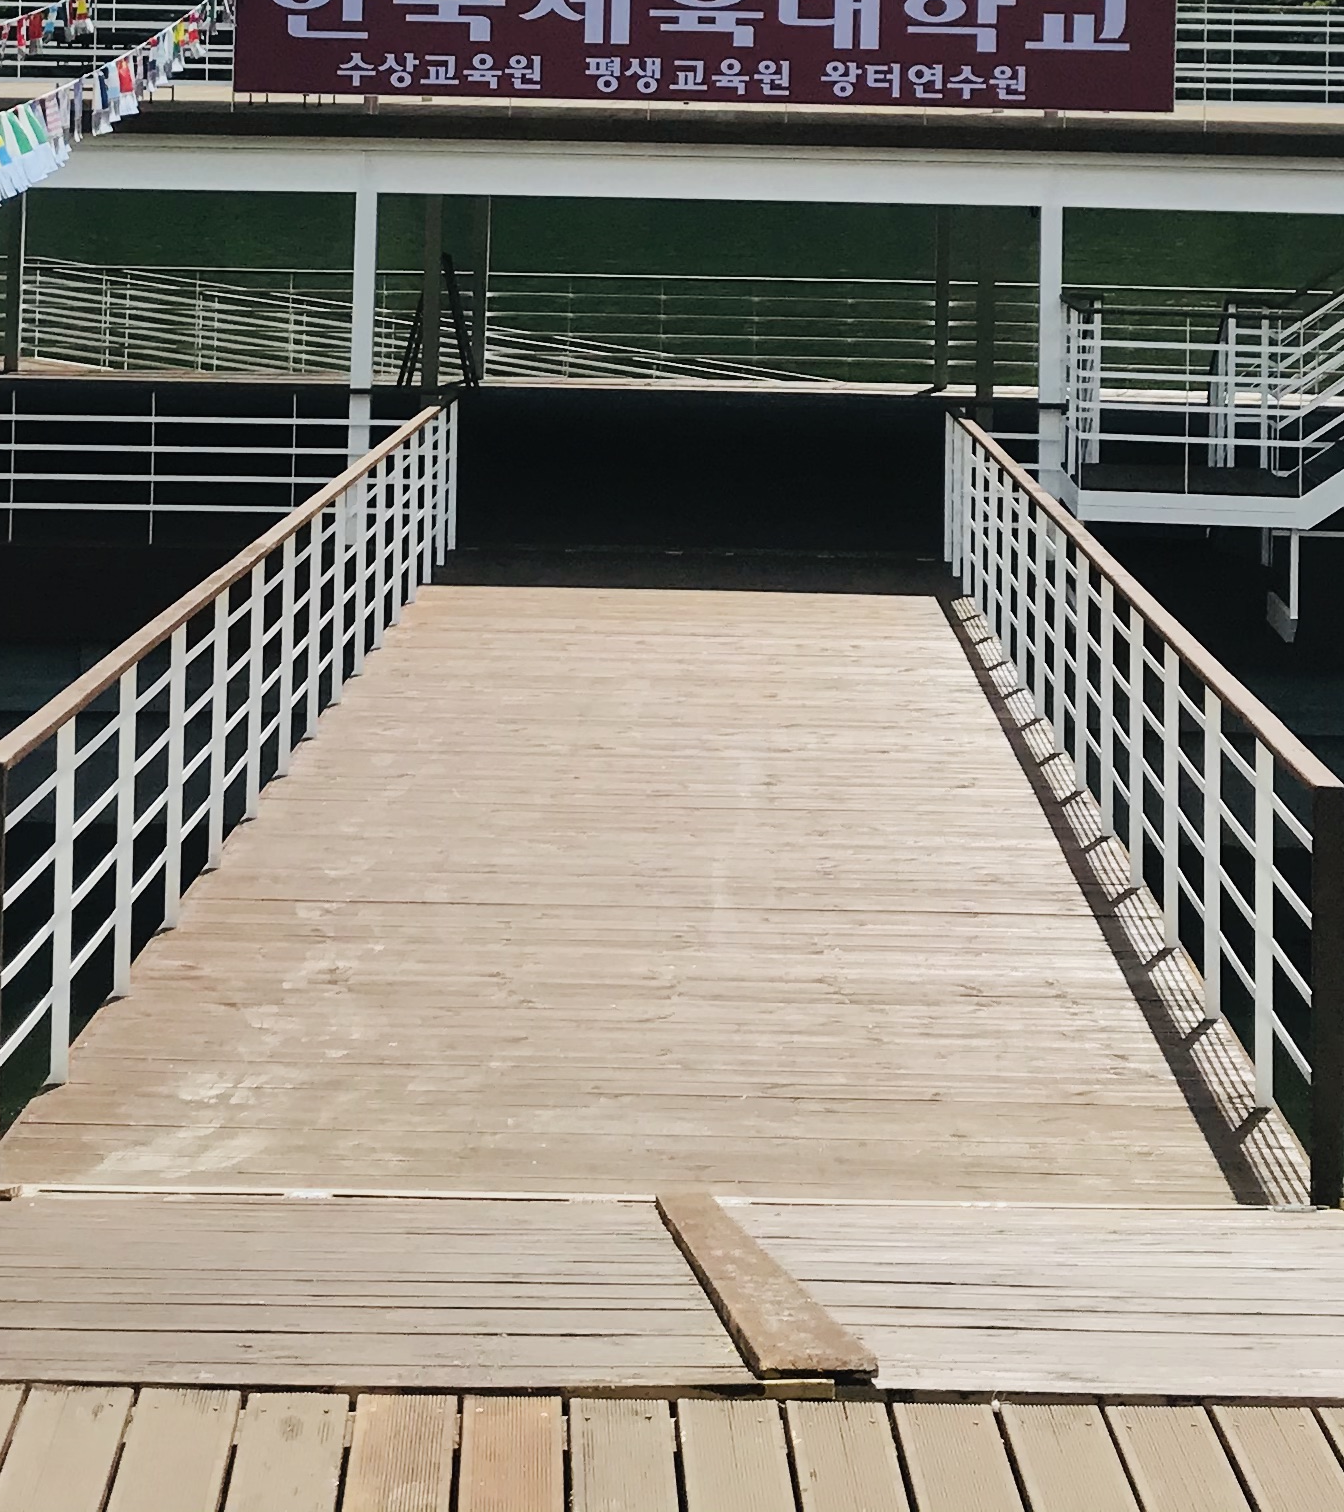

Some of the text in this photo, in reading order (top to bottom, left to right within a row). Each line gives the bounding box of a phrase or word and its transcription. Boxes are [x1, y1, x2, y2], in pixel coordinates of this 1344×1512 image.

[336, 52, 1026, 101] 수상교육원 평생교육원 왕터연수원
